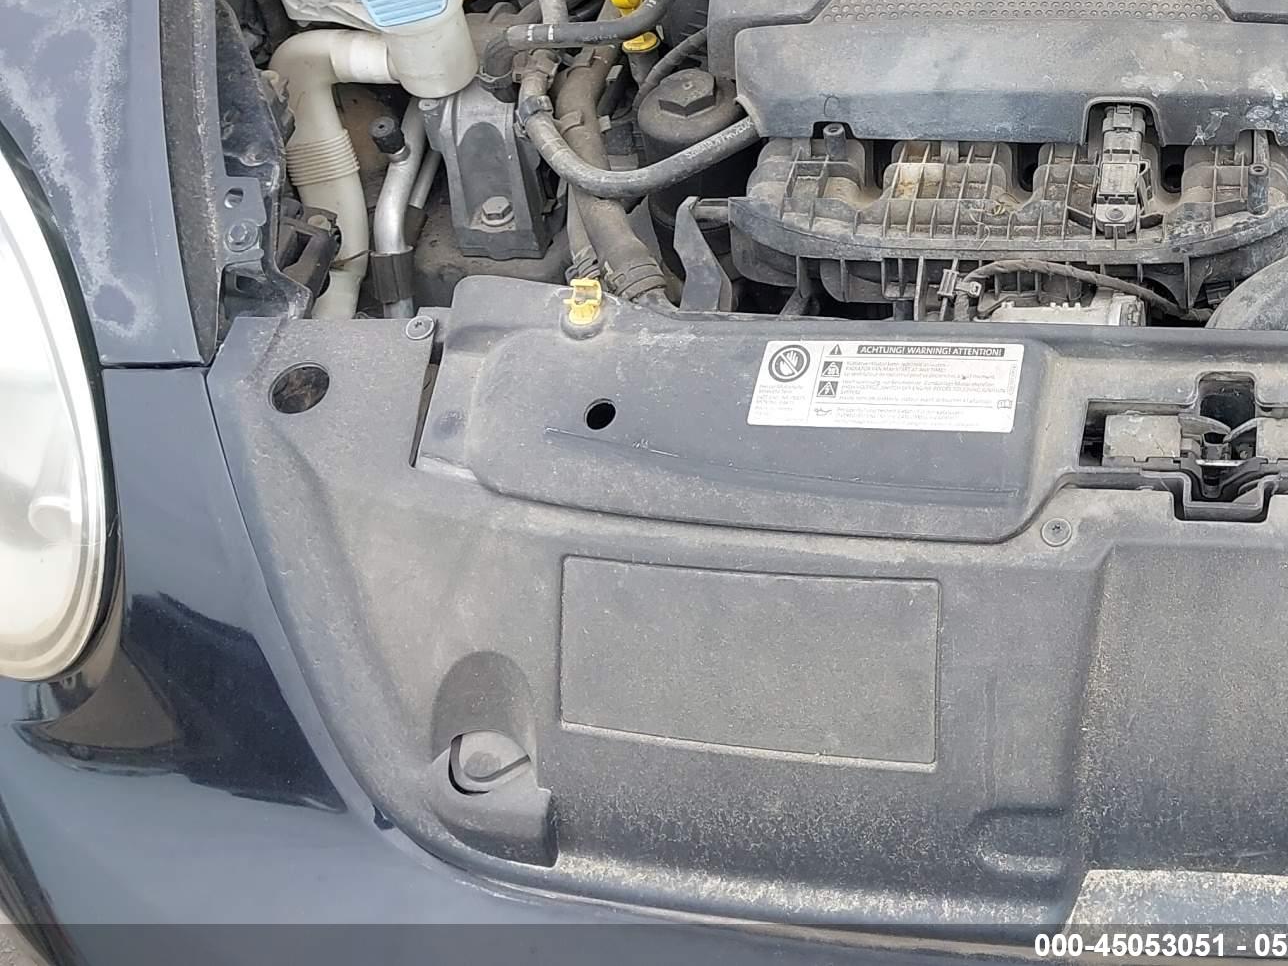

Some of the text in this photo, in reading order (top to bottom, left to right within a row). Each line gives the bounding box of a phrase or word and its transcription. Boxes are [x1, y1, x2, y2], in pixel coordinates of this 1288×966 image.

[860, 345, 1002, 356] ACHTUNG! WARNING! ATTENTION!
